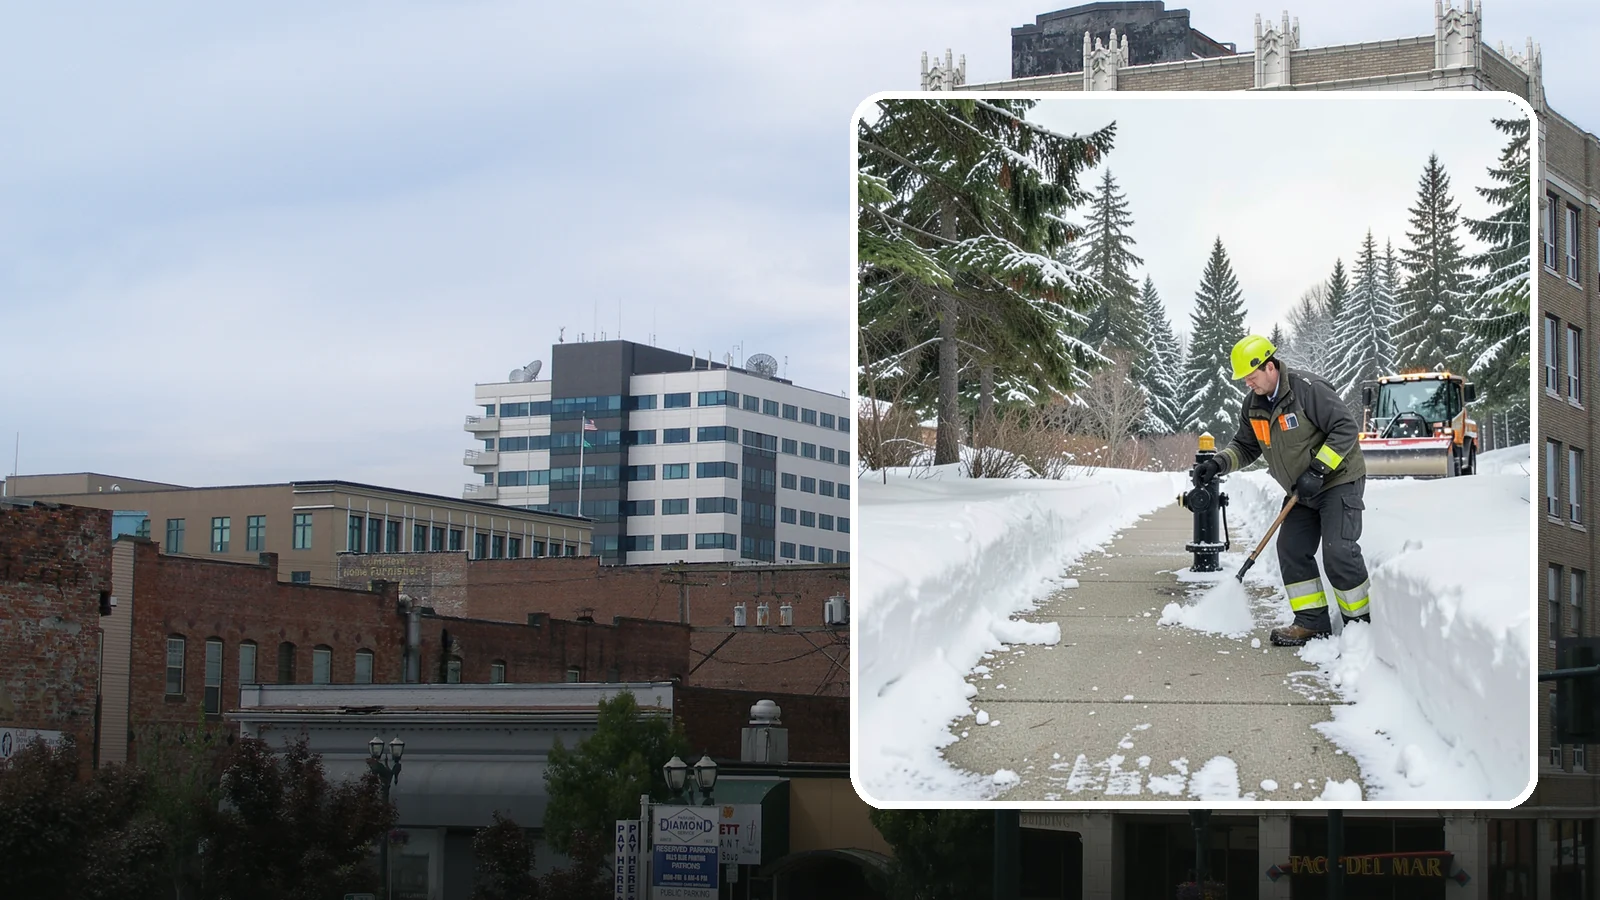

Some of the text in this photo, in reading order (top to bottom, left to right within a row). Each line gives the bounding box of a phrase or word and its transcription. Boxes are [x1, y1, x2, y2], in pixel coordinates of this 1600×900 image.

[370, 566, 428, 576] Furnishers
[660, 818, 713, 833] DIAMOND
[1022, 815, 1070, 828] BUILDING
[656, 845, 716, 854] RESERVED PARKING
[616, 825, 625, 893] PAY HERE
[627, 824, 637, 893] PAY HERE
[721, 852, 739, 861] Soup
[671, 862, 701, 870] PATRONS
[1345, 856, 1385, 875] DEL
[1392, 857, 1442, 877] MAR
[660, 888, 710, 898] PUBLIC PARKING
